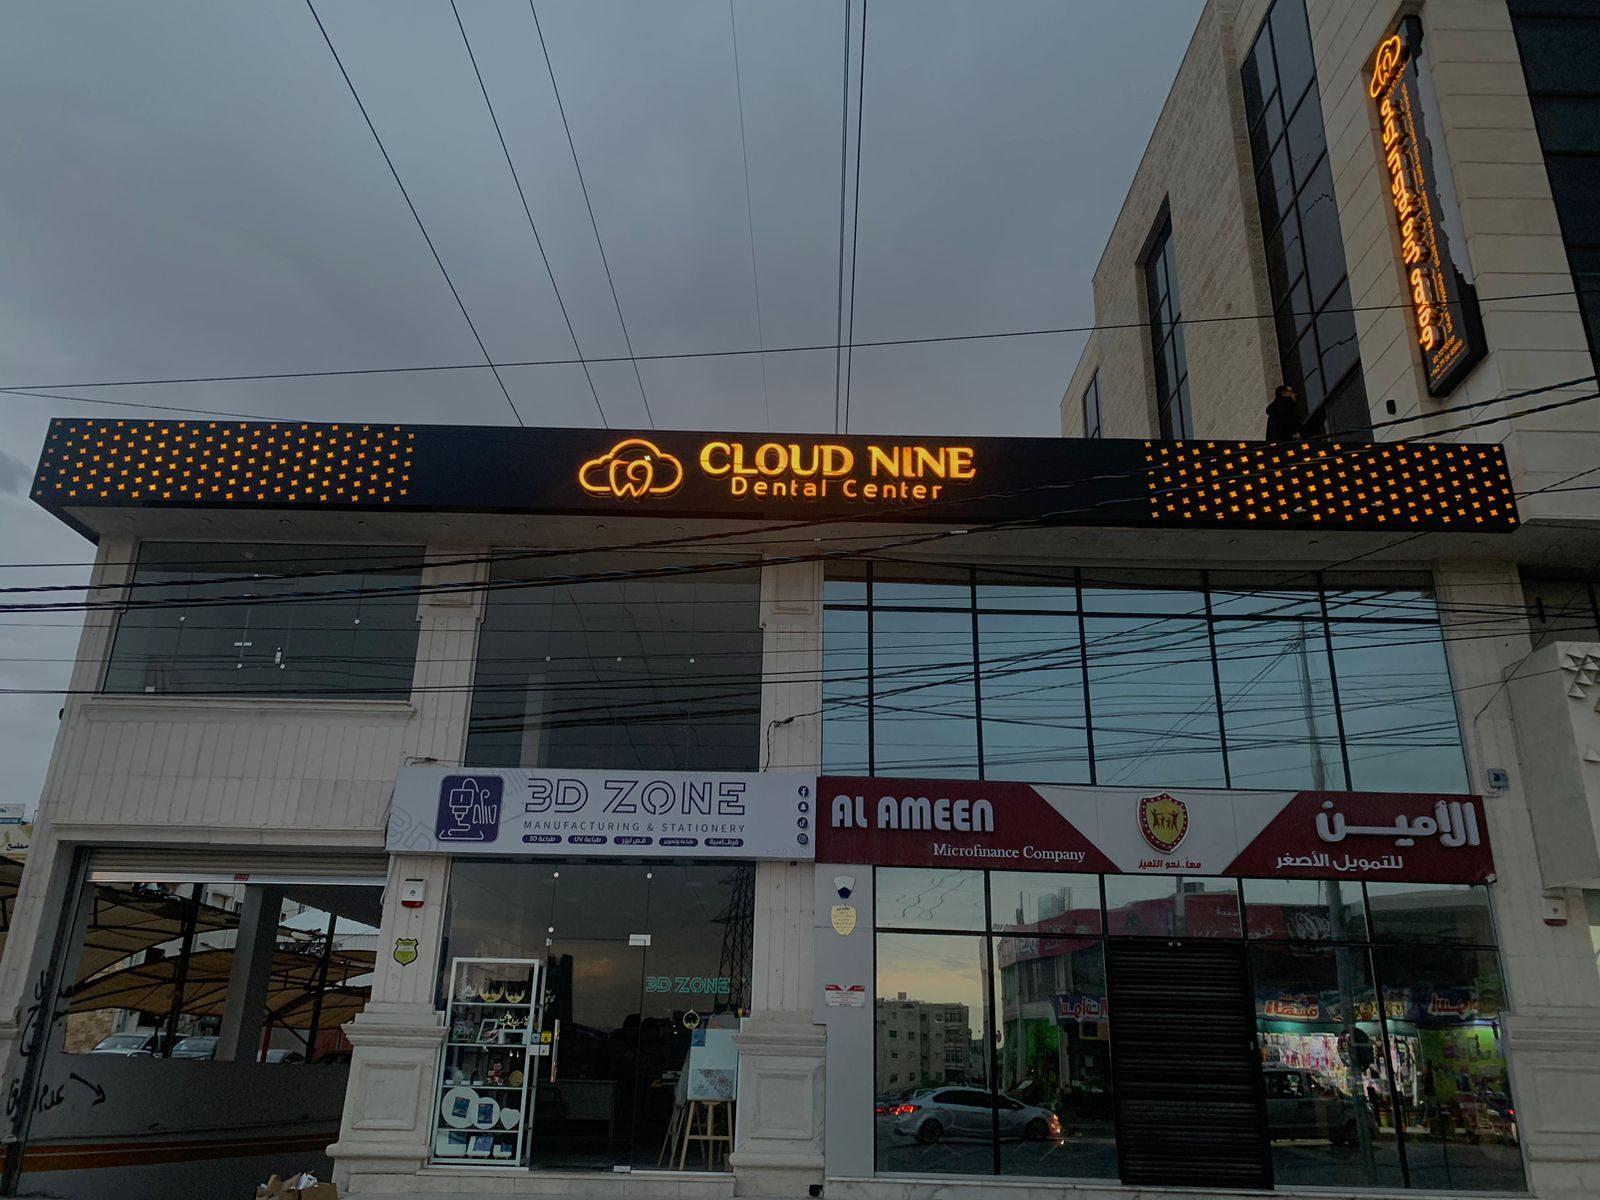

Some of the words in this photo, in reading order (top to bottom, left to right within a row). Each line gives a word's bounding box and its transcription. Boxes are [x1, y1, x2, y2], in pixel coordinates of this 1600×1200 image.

[700, 441, 855, 476] CLOUD
[867, 445, 977, 479] NINE
[731, 476, 827, 496] Dental
[842, 479, 943, 499] Center
[525, 777, 589, 813] 3D
[602, 780, 746, 816] ZONE
[831, 794, 868, 829] AL
[876, 796, 995, 833] AMEEN
[523, 820, 640, 831] MANUFACTURING
[646, 823, 655, 832] &
[661, 823, 745, 833] STATIONERY
[933, 843, 1020, 859] Microfinance
[1022, 846, 1086, 862] Company
[1275, 851, 1330, 869] الأصغر
[1138, 859, 1164, 870] التميز
[1332, 855, 1404, 872] للتمويل
[645, 976, 672, 993] 3D
[674, 976, 731, 994] ZONE
